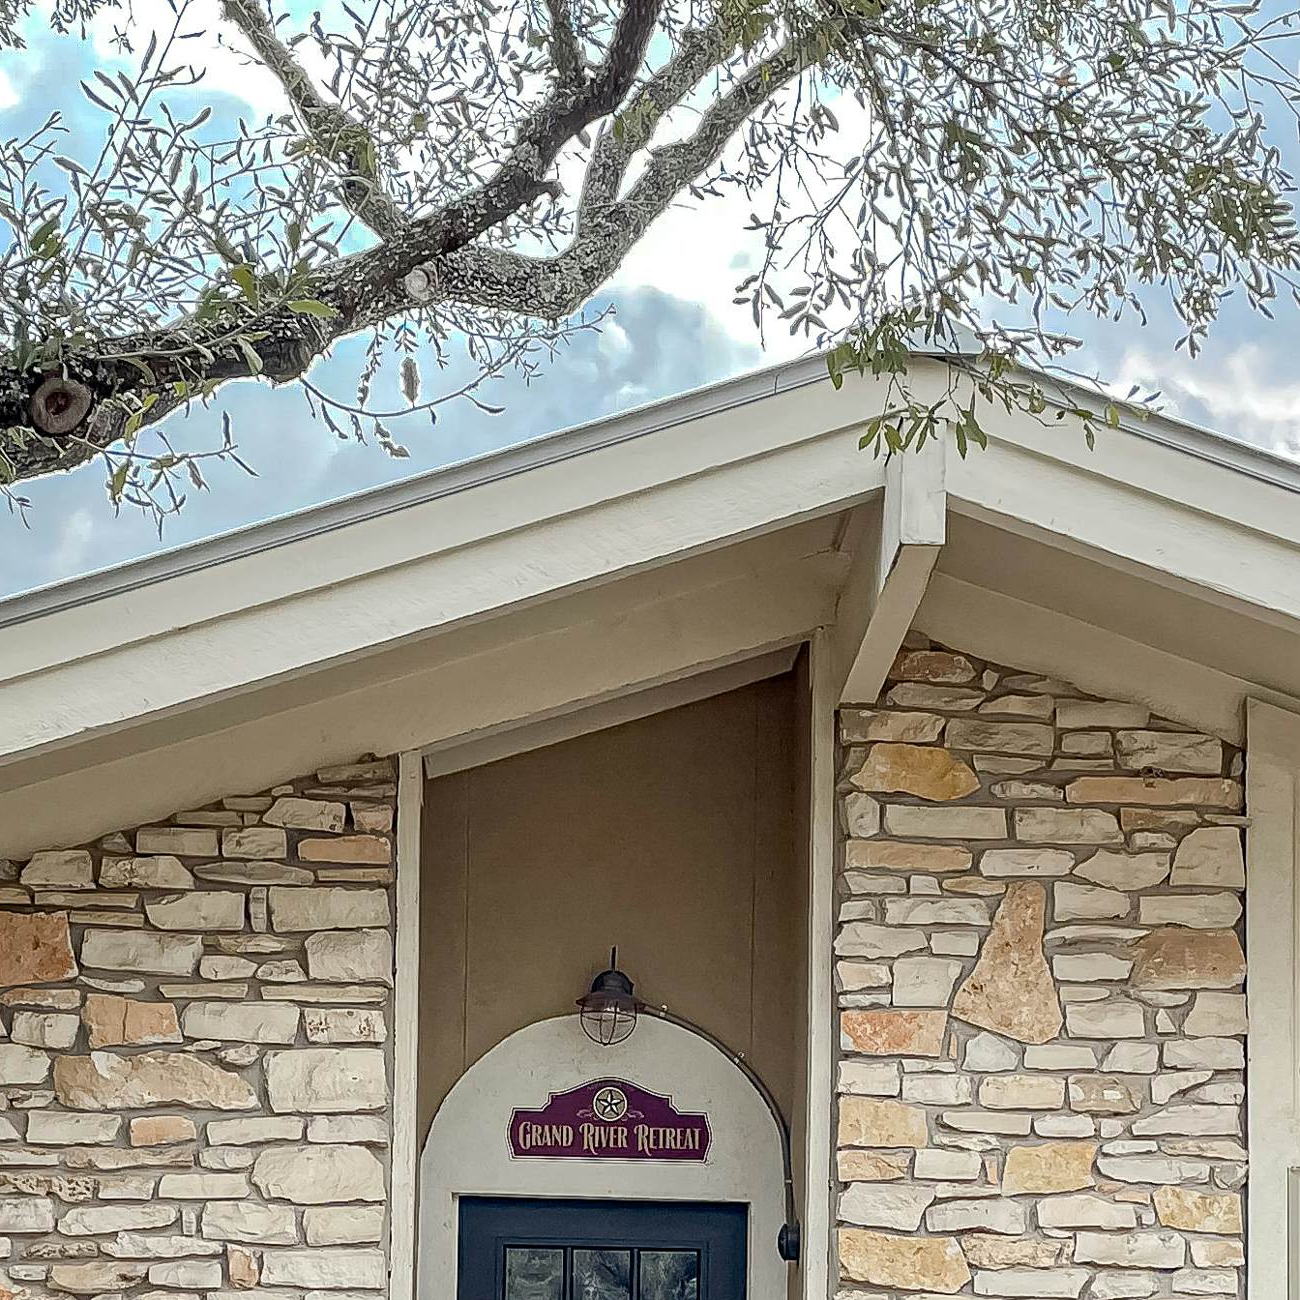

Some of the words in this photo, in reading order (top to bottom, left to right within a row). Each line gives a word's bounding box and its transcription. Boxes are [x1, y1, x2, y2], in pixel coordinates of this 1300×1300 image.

[518, 1121, 573, 1150] GRAND
[579, 1122, 628, 1156] RIVER
[633, 1124, 701, 1156] RETREAT
